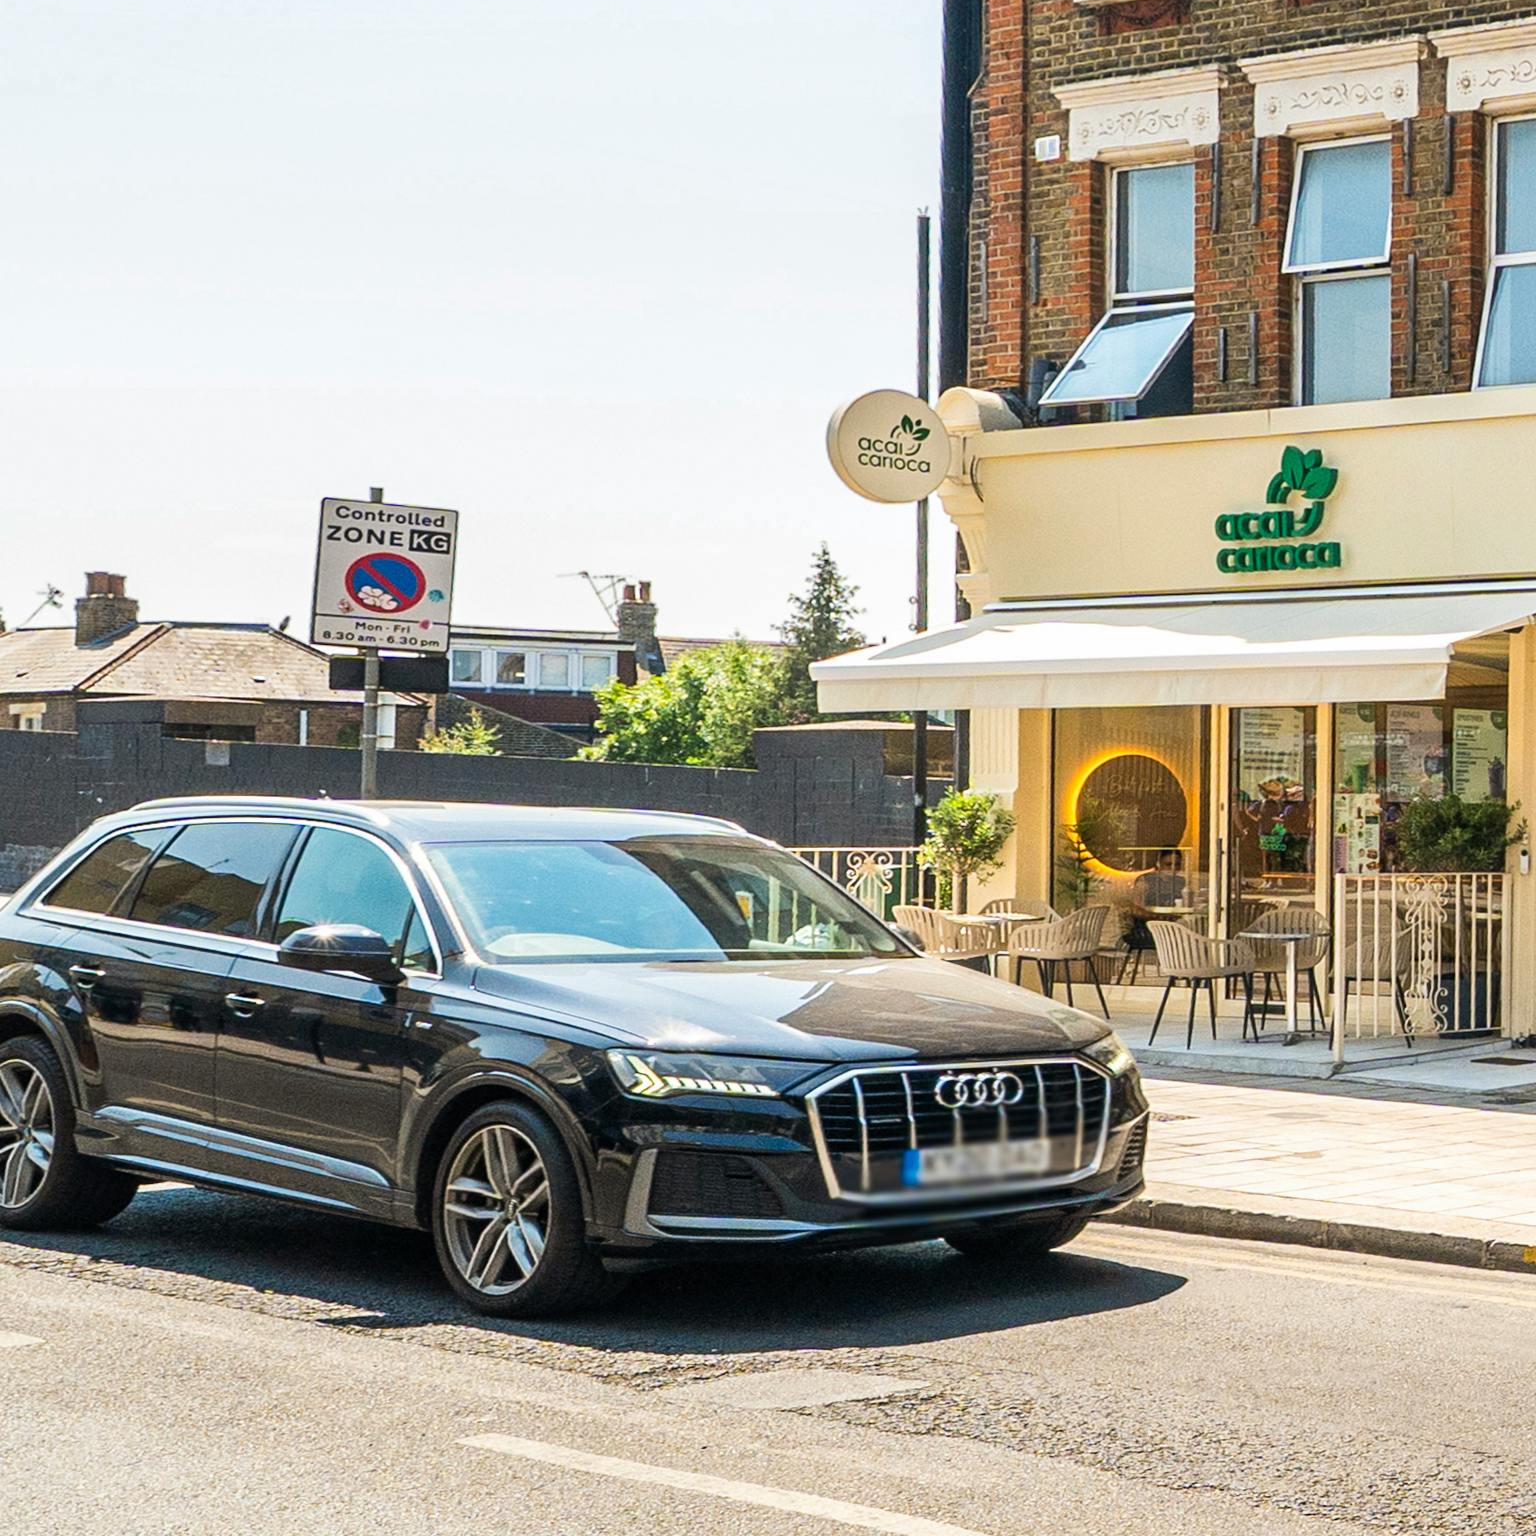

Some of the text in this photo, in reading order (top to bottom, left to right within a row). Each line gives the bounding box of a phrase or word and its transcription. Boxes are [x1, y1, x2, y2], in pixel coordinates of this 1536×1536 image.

[857, 453, 931, 473] carioca
[335, 505, 446, 528] Controlled
[326, 525, 450, 553] ZONE KG
[1216, 542, 1341, 574] carioca
[355, 621, 383, 632] Mon
[393, 624, 410, 634] Fri
[322, 630, 355, 641] 8.30
[357, 633, 377, 643] am
[386, 636, 418, 646] 6.30
[420, 638, 440, 648] pm
